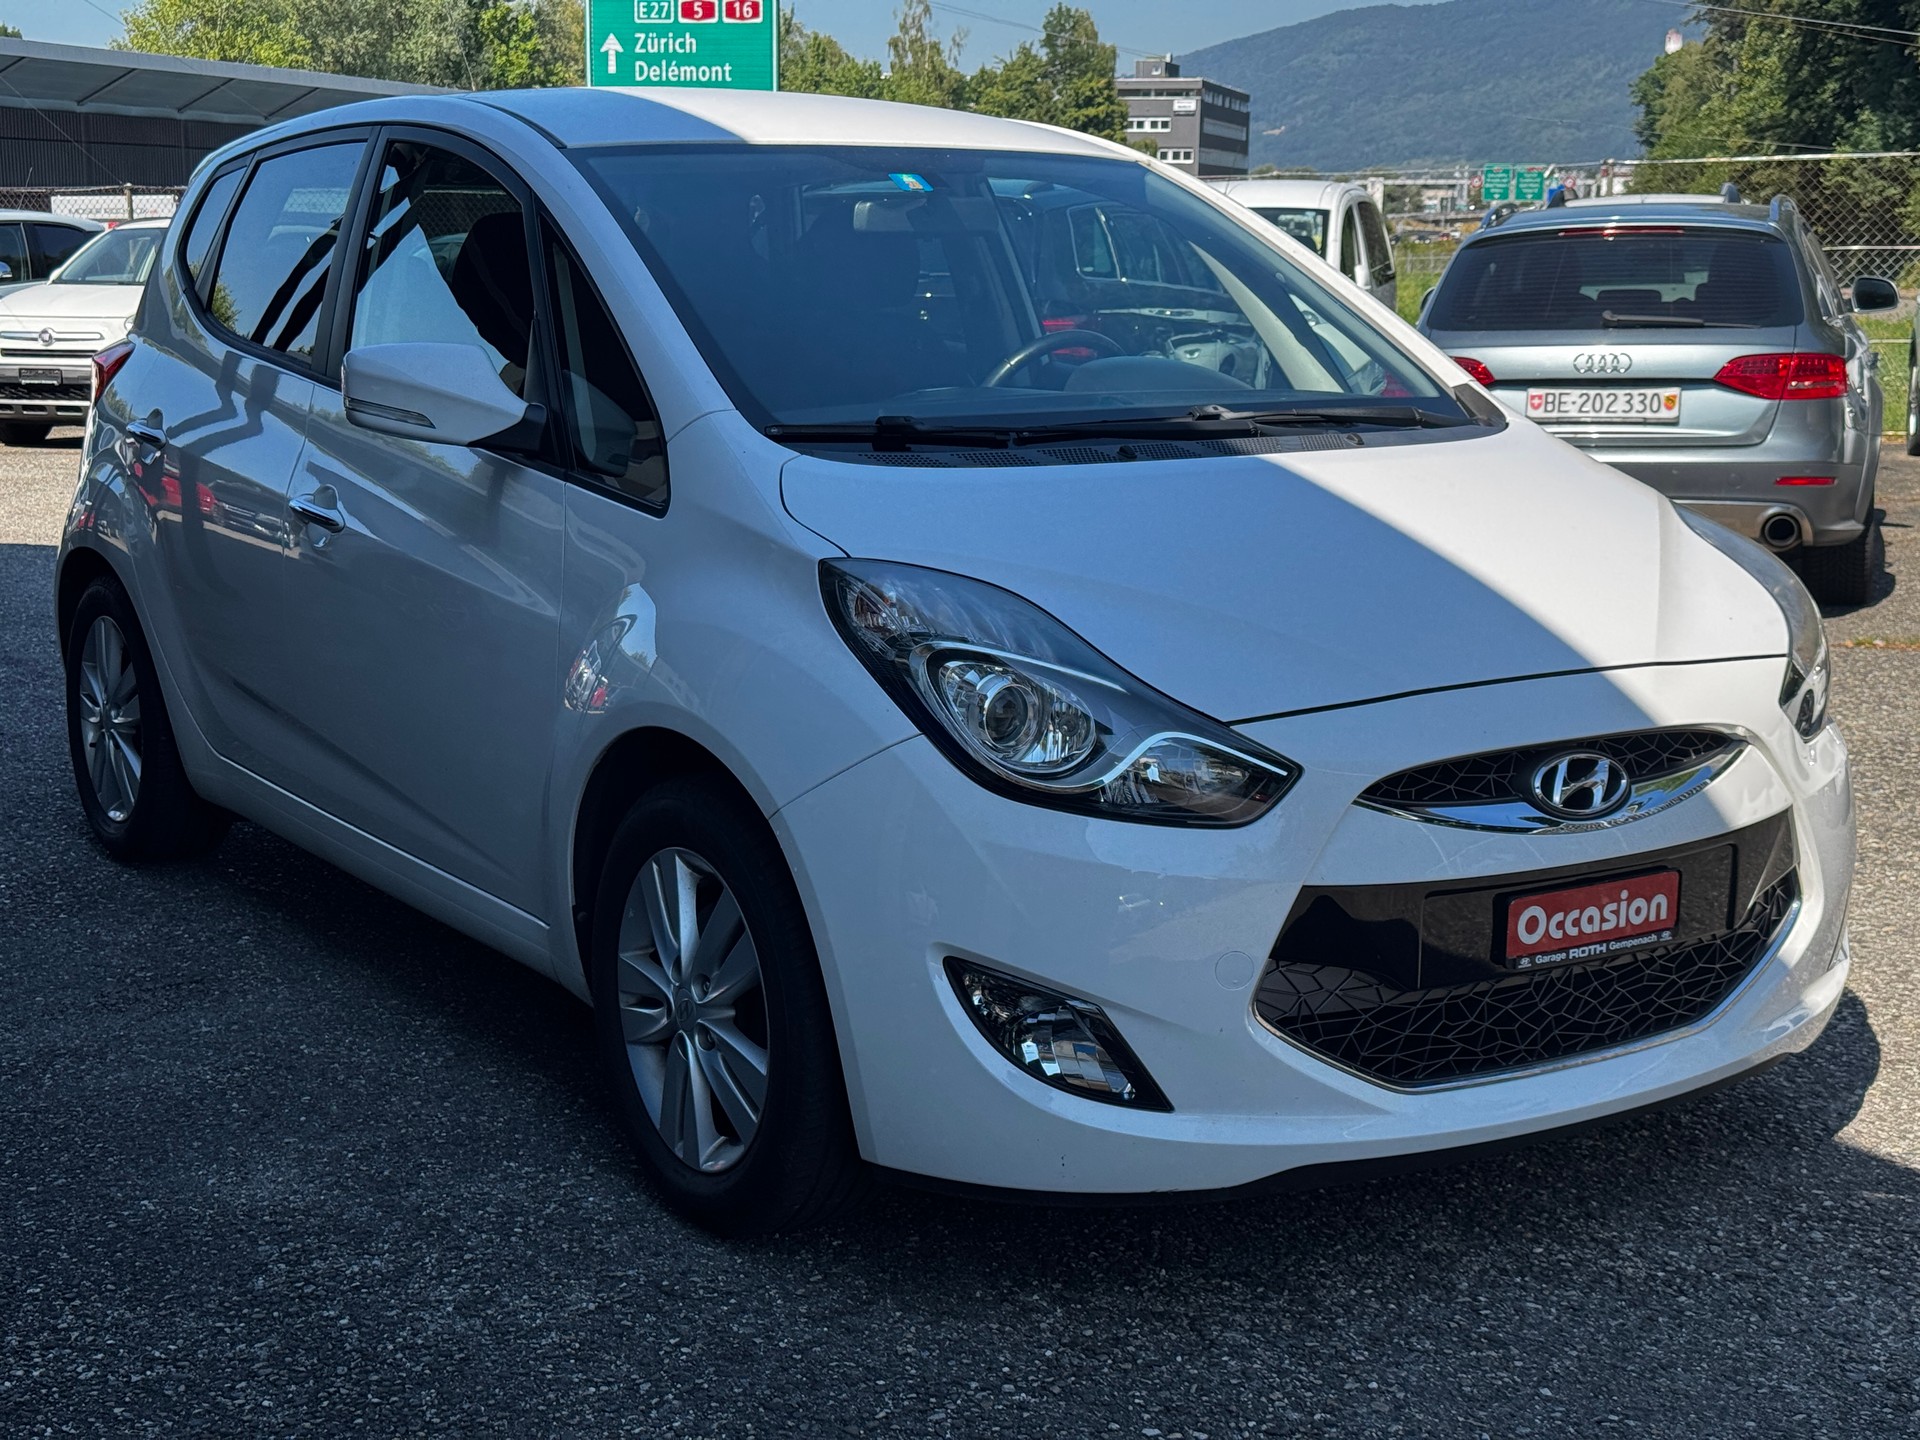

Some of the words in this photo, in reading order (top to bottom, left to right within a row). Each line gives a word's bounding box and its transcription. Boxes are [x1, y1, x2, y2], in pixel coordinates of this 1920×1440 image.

[639, 1, 670, 19] E27
[693, 1, 703, 19] 5
[733, 1, 753, 19] 16
[634, 32, 697, 54] Zürich
[634, 60, 733, 82] Delémont
[1517, 889, 1668, 945] Occasion
[1535, 952, 1567, 964] Garage
[1569, 943, 1607, 959] ROTH
[1609, 934, 1658, 950] Gempenach
